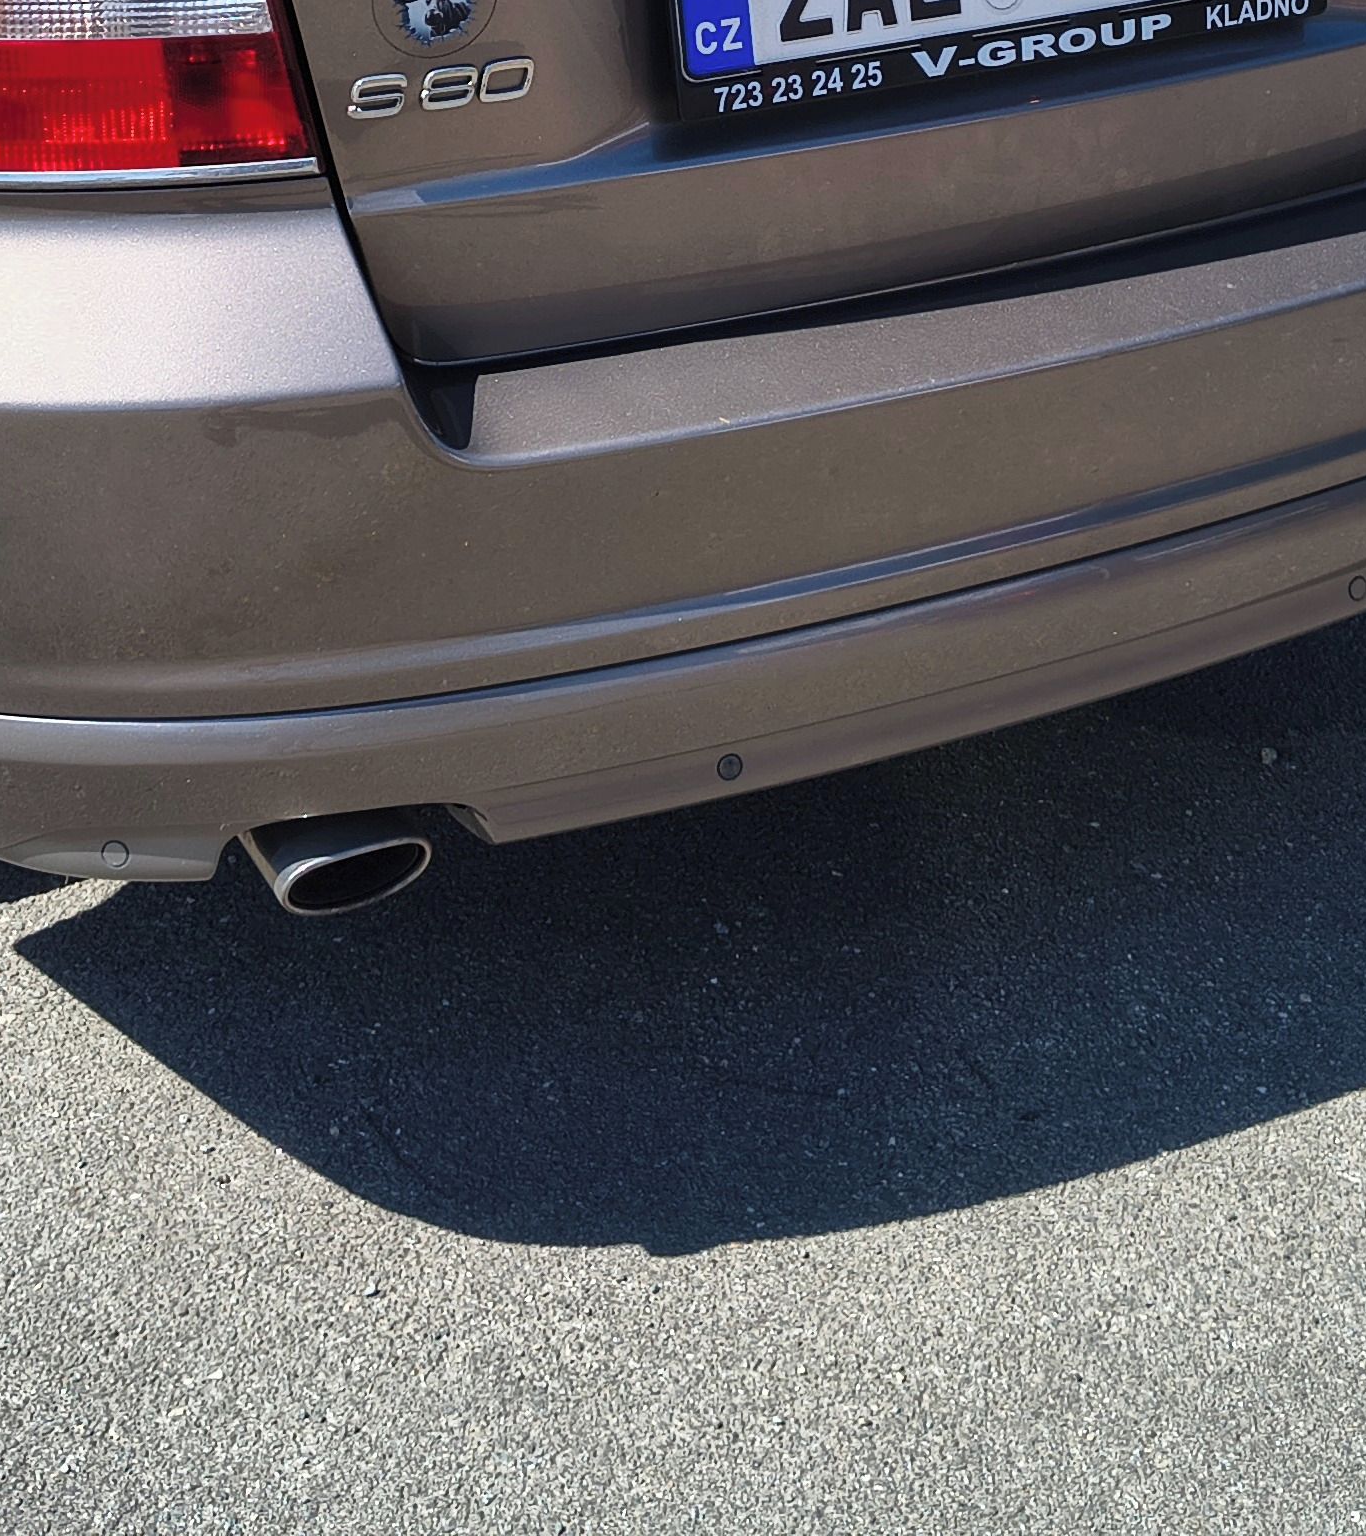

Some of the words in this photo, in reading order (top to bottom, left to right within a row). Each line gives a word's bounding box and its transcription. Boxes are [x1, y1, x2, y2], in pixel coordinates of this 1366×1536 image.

[694, 16, 744, 56] CZ
[713, 80, 764, 114] 723
[771, 73, 804, 106] 23
[811, 67, 845, 98] 24
[851, 60, 884, 91] 25
[911, 13, 1174, 79] V-GROUP
[346, 56, 535, 120] S80
